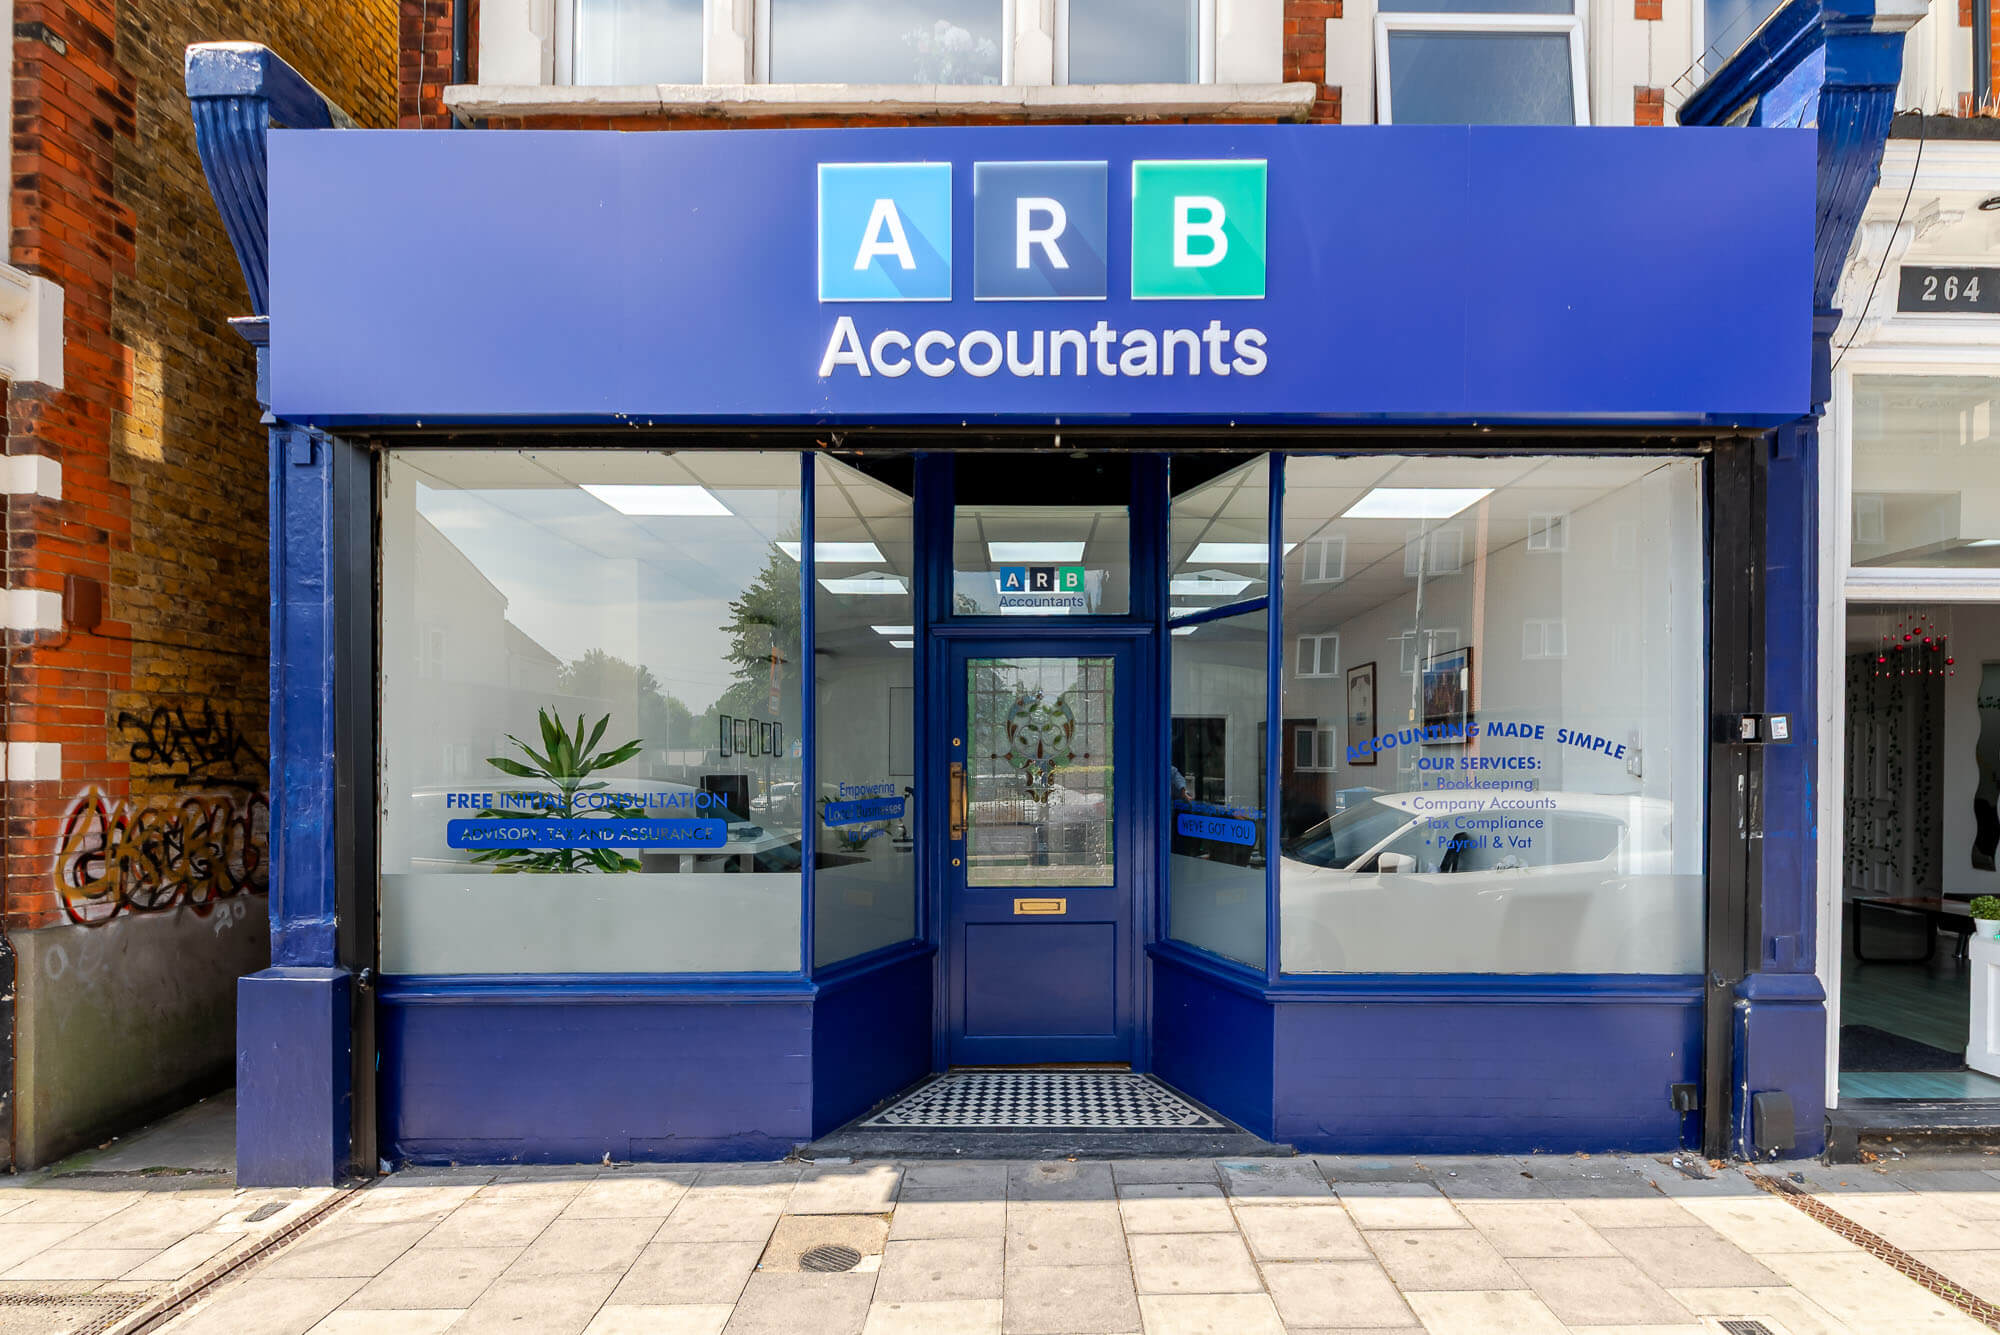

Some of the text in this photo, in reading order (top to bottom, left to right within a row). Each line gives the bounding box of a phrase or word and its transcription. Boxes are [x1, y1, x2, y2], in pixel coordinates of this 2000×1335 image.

[1922, 275, 1980, 302] 264
[818, 316, 1268, 378] Accountants
[999, 595, 1084, 608] Accountants
[1346, 721, 1627, 762] ACCOUNTING MADE SIMPLE
[1418, 757, 1541, 770] OUR SERVICES:
[840, 781, 895, 799] Empowering
[1437, 776, 1534, 792] Bookkeeping
[447, 792, 728, 809] FREE INITIAL CONSULTATION
[1413, 797, 1557, 813] Company Accounts
[1208, 822, 1226, 836] GOT
[1231, 823, 1250, 840] YOU
[1425, 816, 1544, 832] Tax Compliance
[461, 827, 713, 841] ADVISORY, TAX AND ASSURANCE
[1438, 835, 1533, 852] Payroll & Vat
